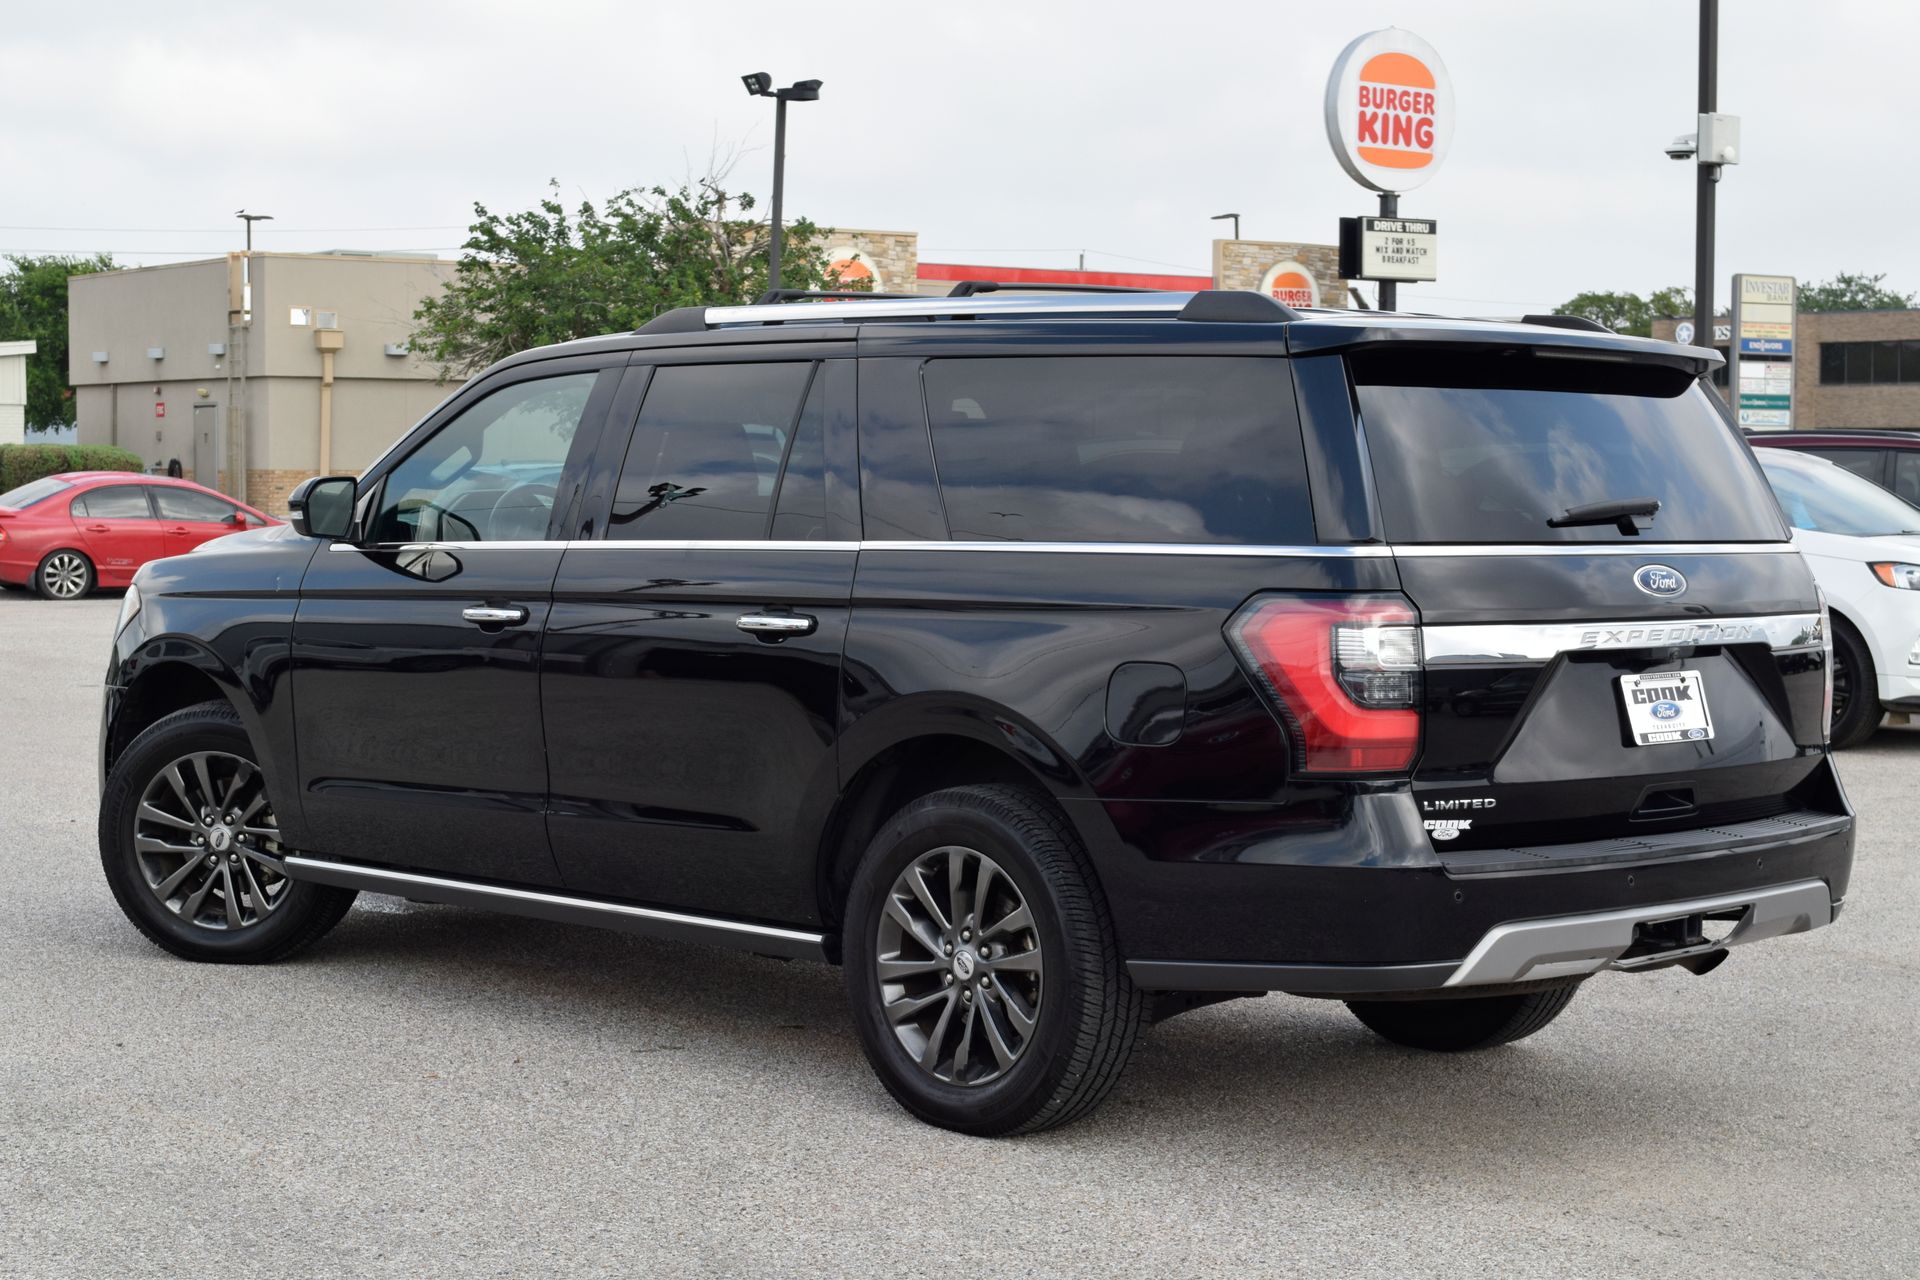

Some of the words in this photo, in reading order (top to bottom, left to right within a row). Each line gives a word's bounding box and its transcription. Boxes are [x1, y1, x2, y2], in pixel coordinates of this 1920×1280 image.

[1359, 85, 1435, 115] BURGER
[1358, 110, 1434, 149] KING
[1373, 220, 1403, 232] DRIVE
[1405, 222, 1430, 233] THRU
[1391, 237, 1403, 245] FOR
[1375, 246, 1388, 254] MIX
[1391, 247, 1403, 255] AND
[1405, 248, 1427, 256] MATCH
[1382, 255, 1419, 264] BREAKFAST
[1745, 279, 1790, 294] INVESTAR
[1650, 570, 1677, 589] Ford
[1580, 624, 1753, 645] EXPEDITION
[1631, 685, 1693, 704] COOK
[1657, 704, 1676, 718] Ford
[1648, 731, 1683, 742] COOK
[1423, 798, 1497, 811] LIMITED
[1423, 819, 1473, 830] COOK
